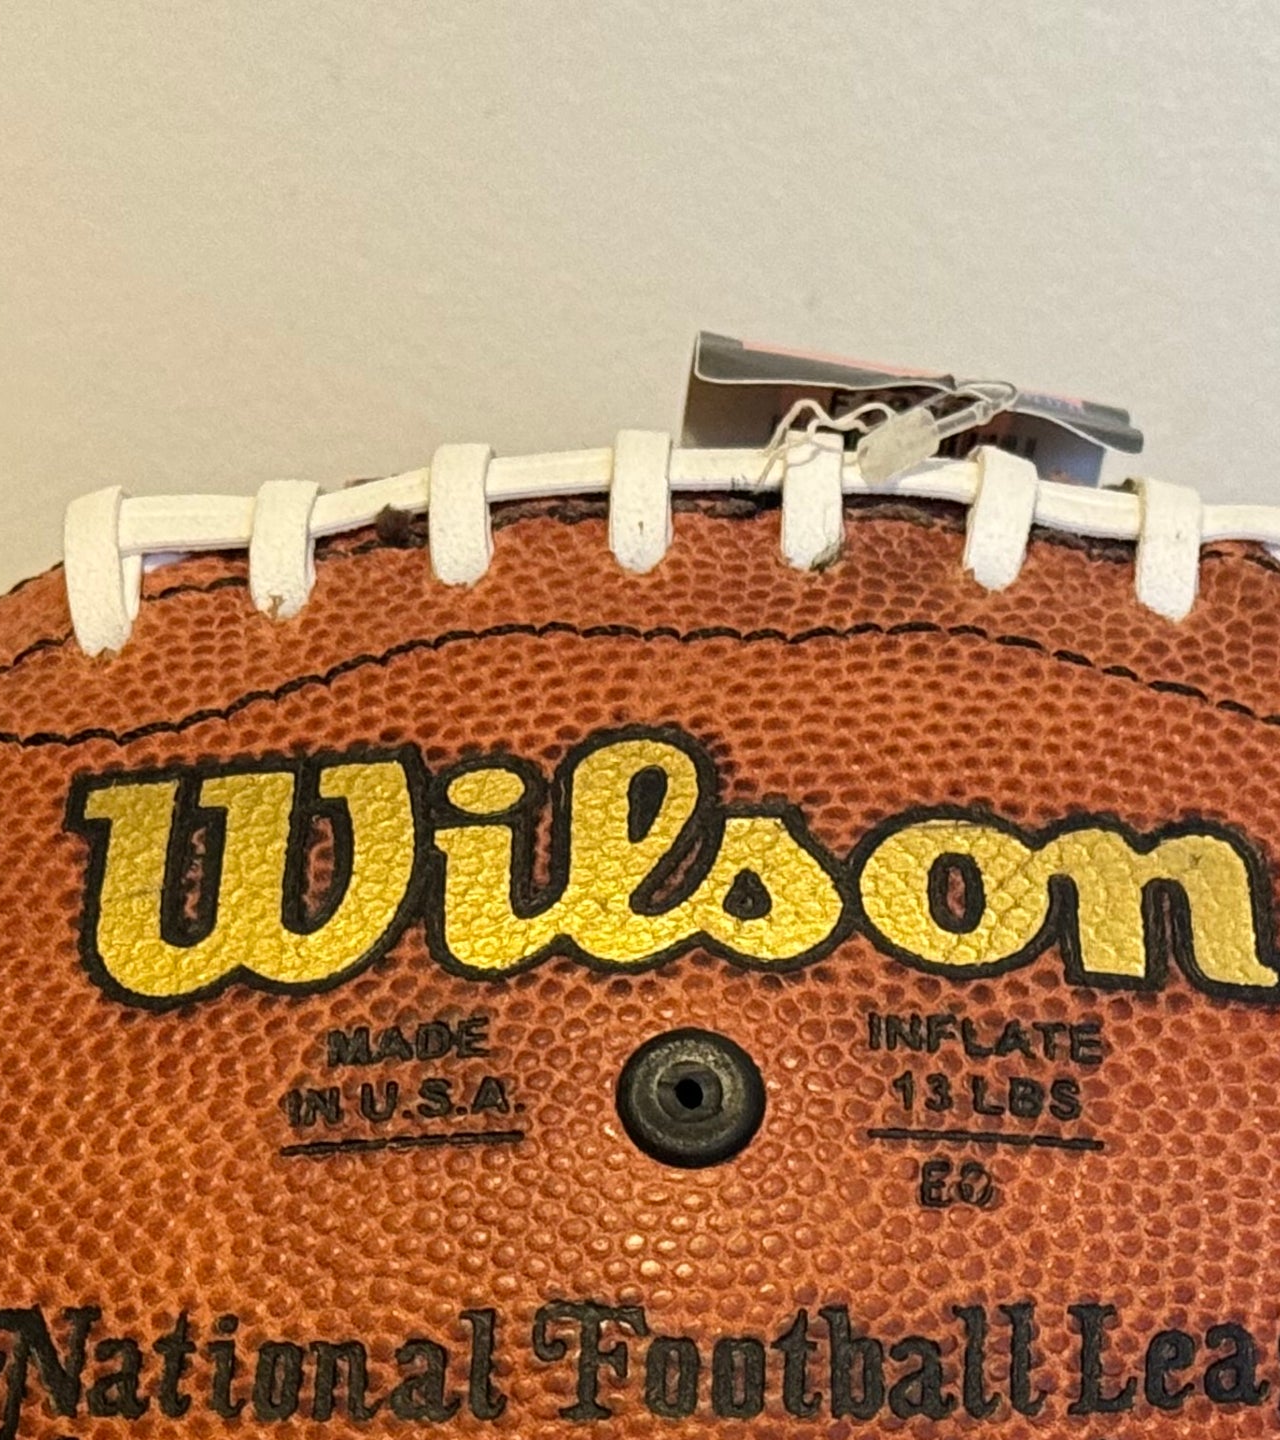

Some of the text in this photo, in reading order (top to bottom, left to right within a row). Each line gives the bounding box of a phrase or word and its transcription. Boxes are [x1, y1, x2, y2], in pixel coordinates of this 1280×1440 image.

[327, 1017, 490, 1067] MADE
[868, 1012, 1104, 1064] INFLATE
[286, 1076, 525, 1127] IN U.S.A.
[893, 1070, 1082, 1121] 13 LBS
[532, 1300, 1046, 1421] Football
